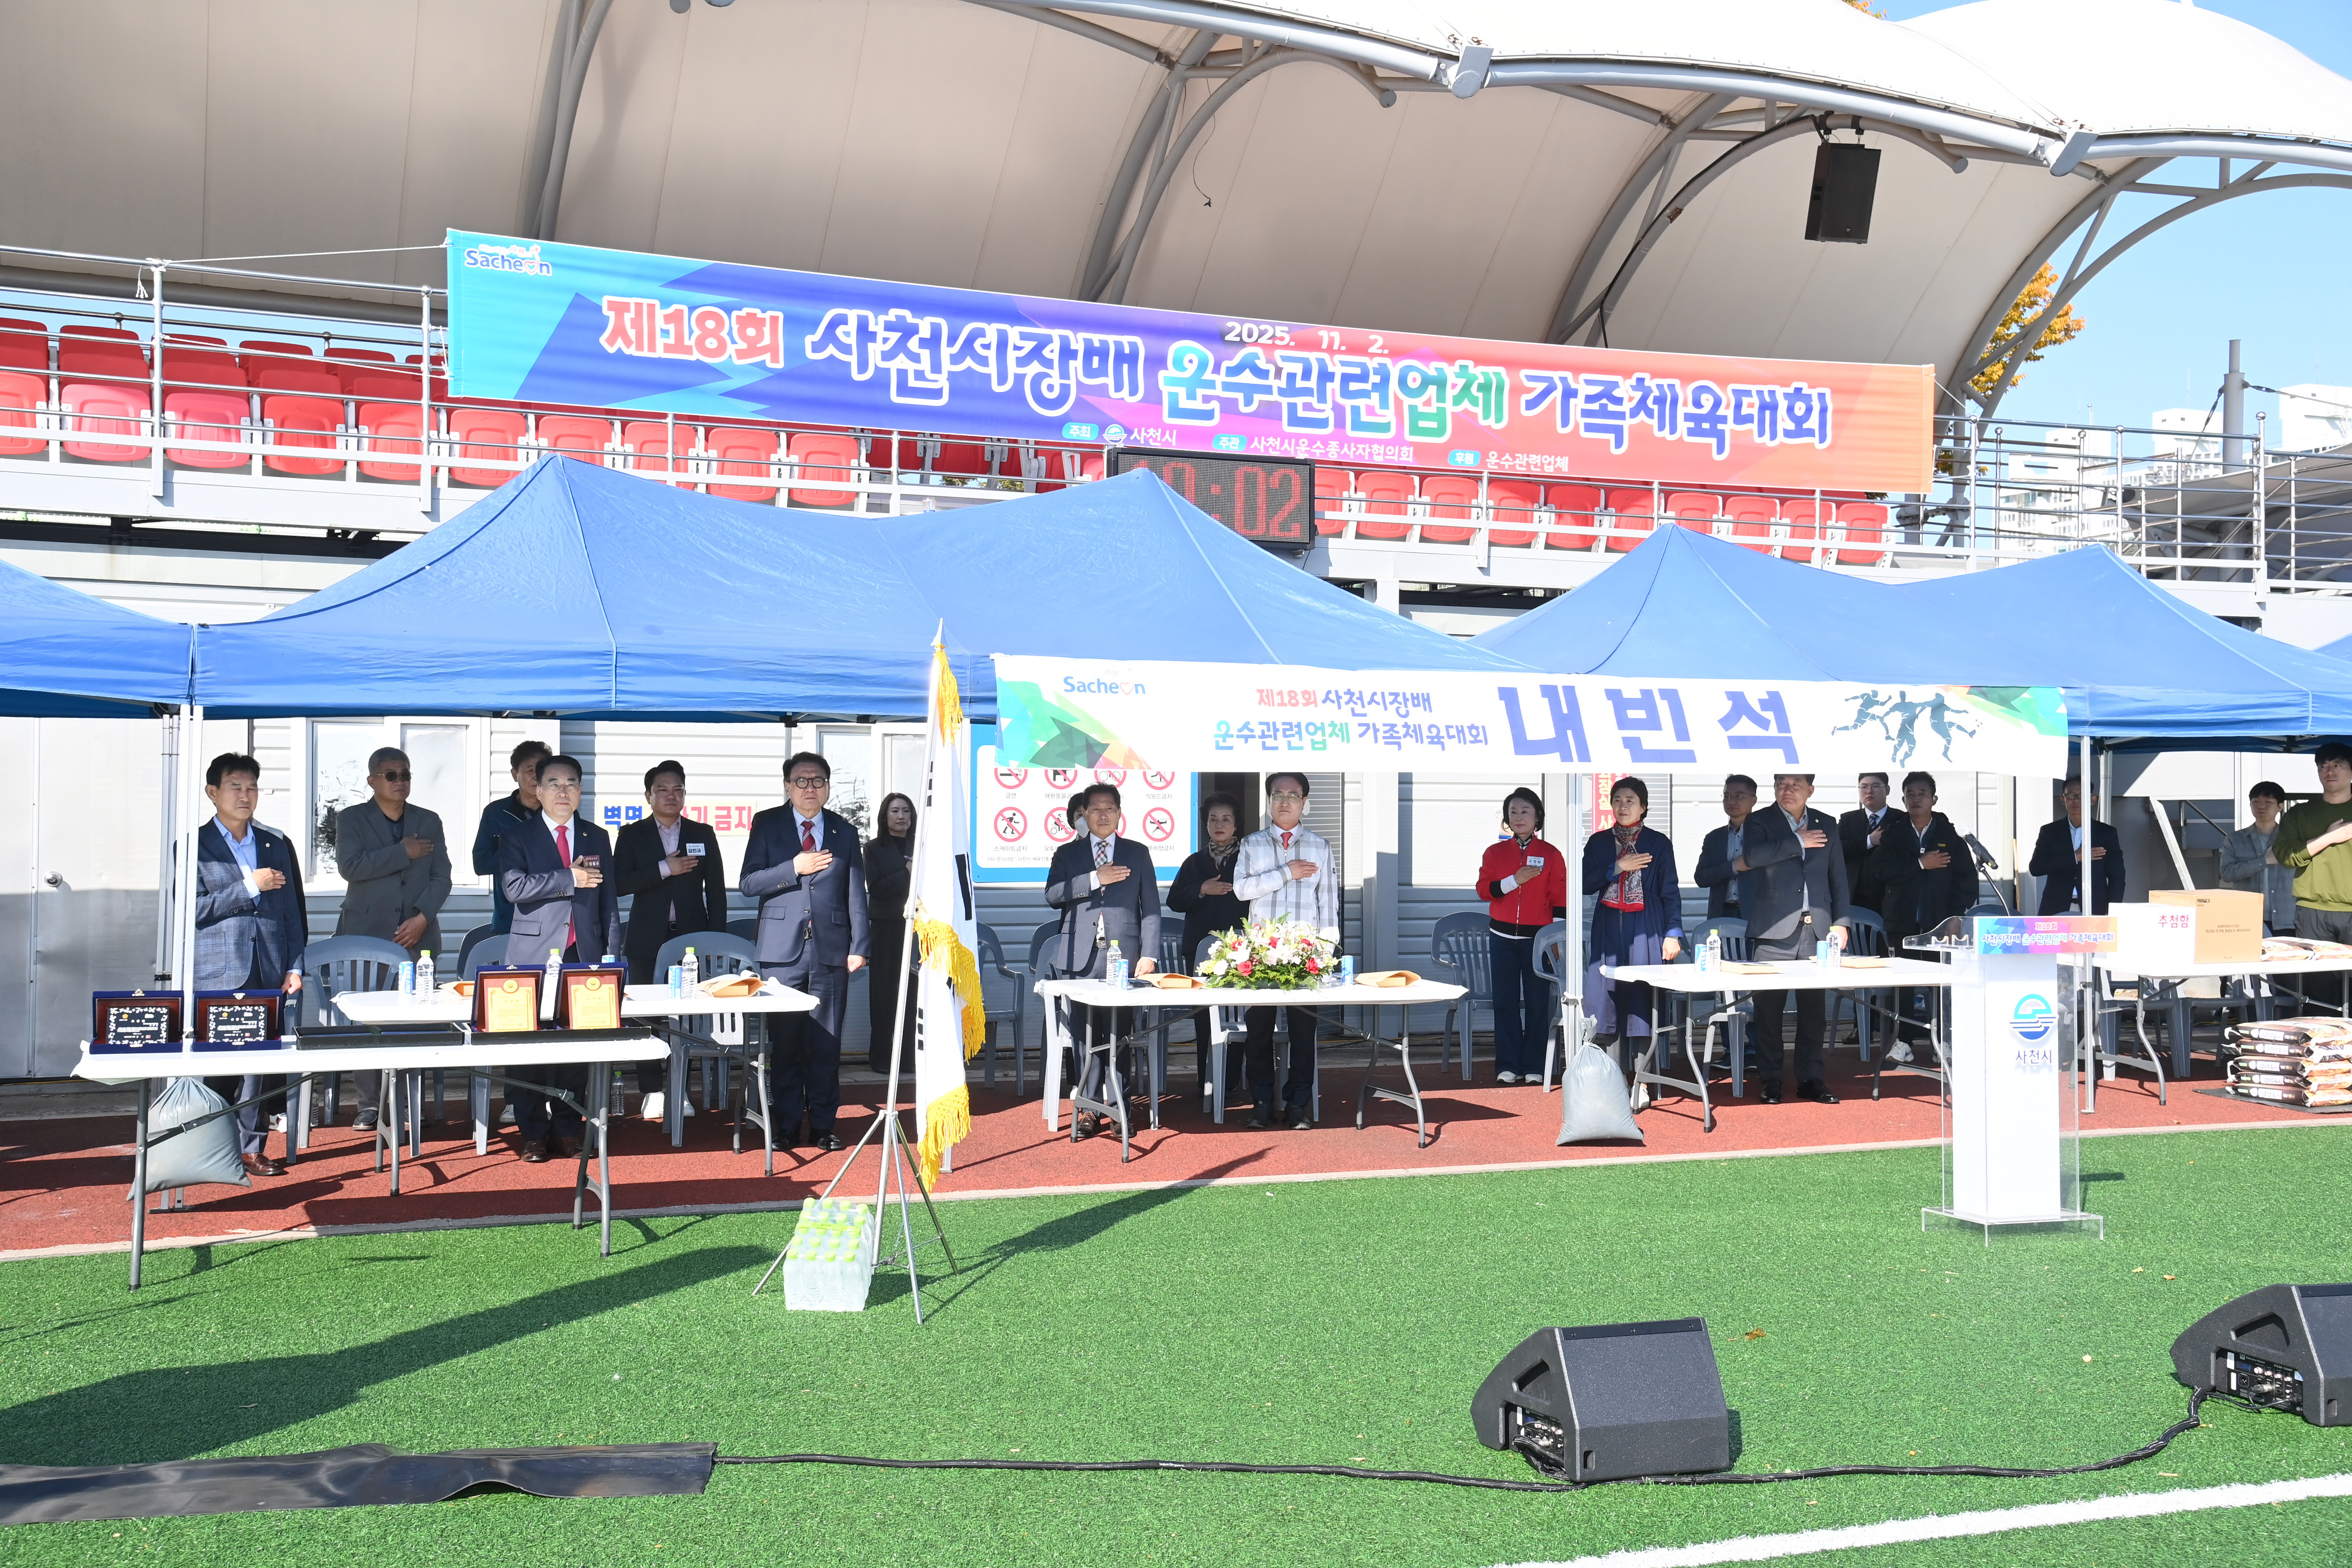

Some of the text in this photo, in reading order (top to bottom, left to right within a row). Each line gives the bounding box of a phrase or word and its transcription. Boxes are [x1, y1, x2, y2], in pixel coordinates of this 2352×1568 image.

[1224, 321, 1389, 355] 2025. 11. 2.
[601, 296, 1832, 460] 제18회 사천시장배 운수관련업체 가족체육대회
[1069, 425, 1177, 446] 주최 사천시
[1218, 436, 1414, 462] 주관 사천시운수종사자협의회
[1454, 451, 1569, 472] 후원 운수관련업체
[1257, 688, 1432, 718] 제18회 사천시장배
[1213, 720, 1489, 752] 운수관련업체 가족체육대회
[604, 805, 643, 831] 벽면
[714, 805, 752, 831] 금지
[2158, 915, 2190, 928] 추첨함
[1982, 933, 2114, 945] 사천시장배 운수관련업체 가족체육대회
[2015, 1049, 2052, 1064] 사천시
